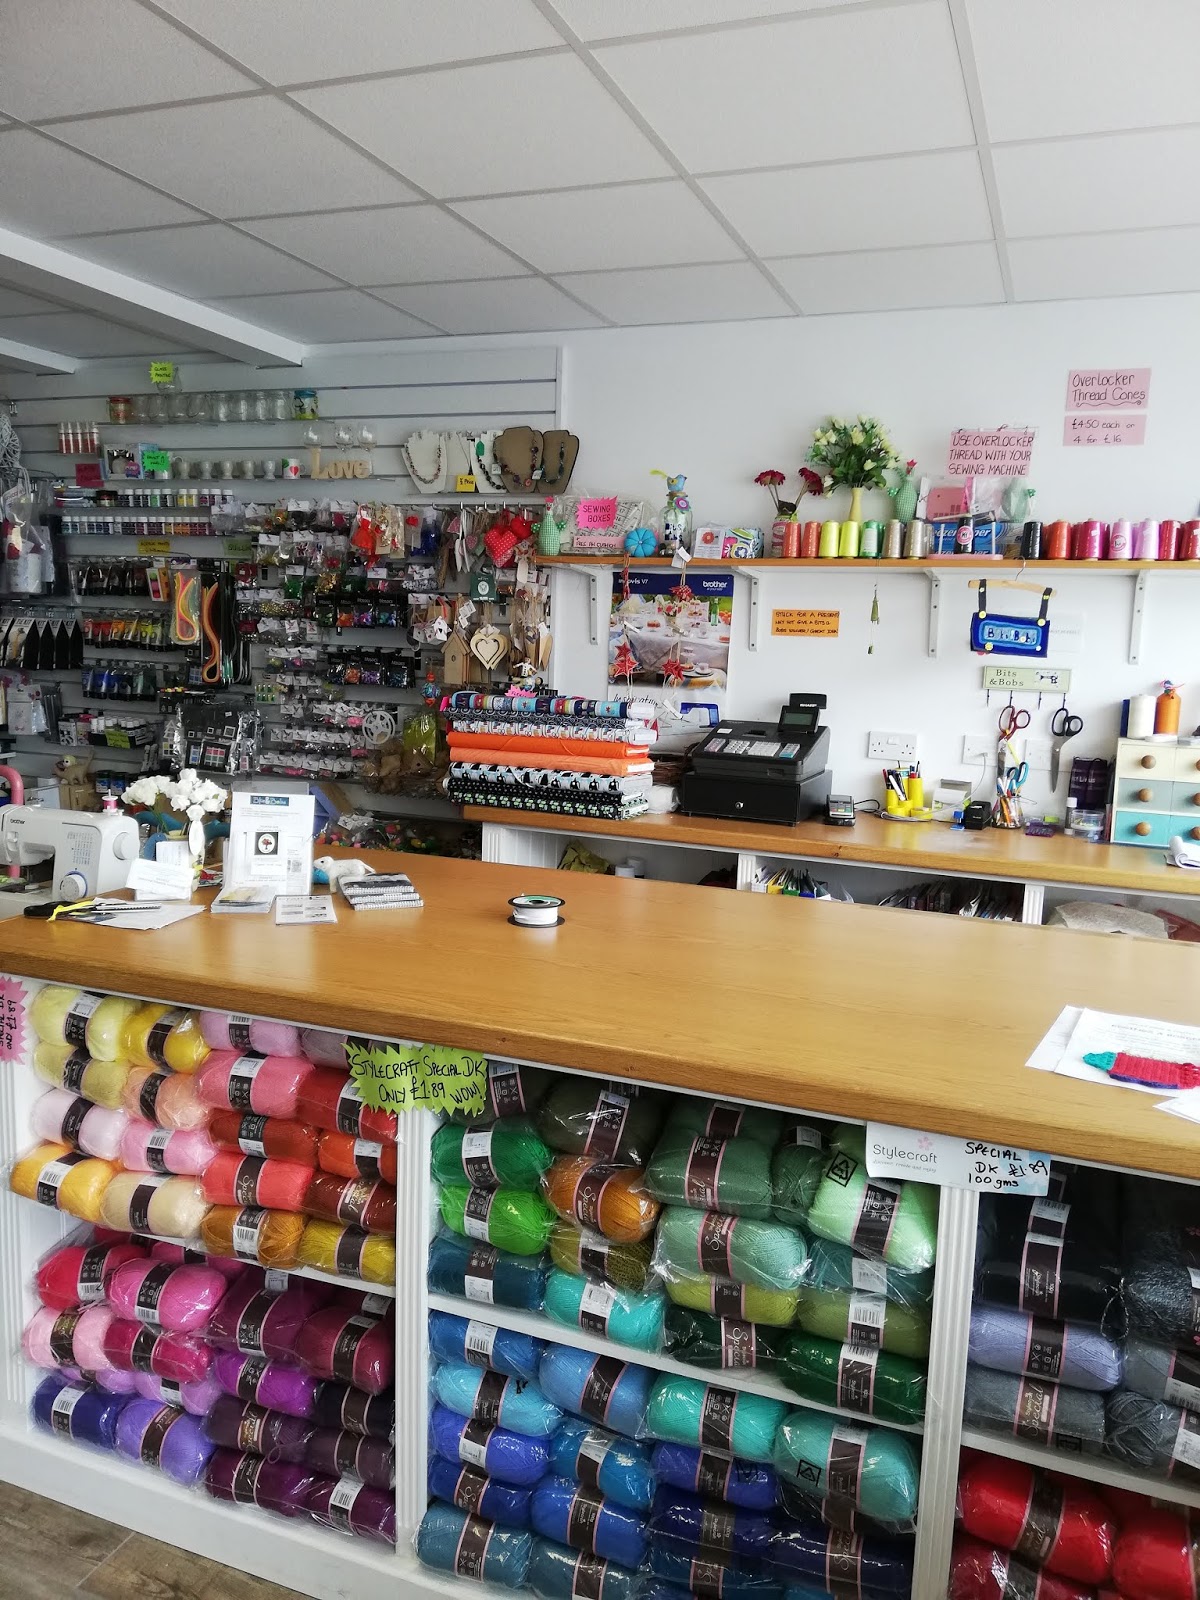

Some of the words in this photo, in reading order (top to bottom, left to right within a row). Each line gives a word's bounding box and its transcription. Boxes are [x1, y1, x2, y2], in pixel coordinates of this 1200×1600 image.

[1072, 372, 1135, 388] Overlocker
[1072, 388, 1108, 402] Thread
[1112, 386, 1146, 401] Cones
[1102, 421, 1120, 429] each
[952, 434, 973, 447] USE
[973, 435, 1034, 447] OVERLOCKER
[949, 449, 983, 461] THREAD
[985, 450, 1008, 461] WITH
[1009, 450, 1032, 461] YOUR
[948, 462, 985, 476] SEWING
[987, 464, 1028, 476] MACHINE
[582, 505, 611, 513] SEWING
[587, 513, 611, 522] BOXES
[703, 580, 728, 588] brother
[996, 669, 1017, 677] Bits
[351, 1053, 420, 1079] STYLECRAFT
[423, 1055, 462, 1077] SPECIAL
[461, 1056, 485, 1077] DK
[378, 1083, 406, 1104] ONLY
[410, 1076, 446, 1101] £1.89
[450, 1081, 483, 1104] WOW!
[873, 1144, 938, 1164] Stylecraft
[964, 1141, 1022, 1162] SPECIAL
[974, 1161, 998, 1174] DK
[1008, 1160, 1049, 1178] £1.89
[968, 1173, 992, 1185] 100
